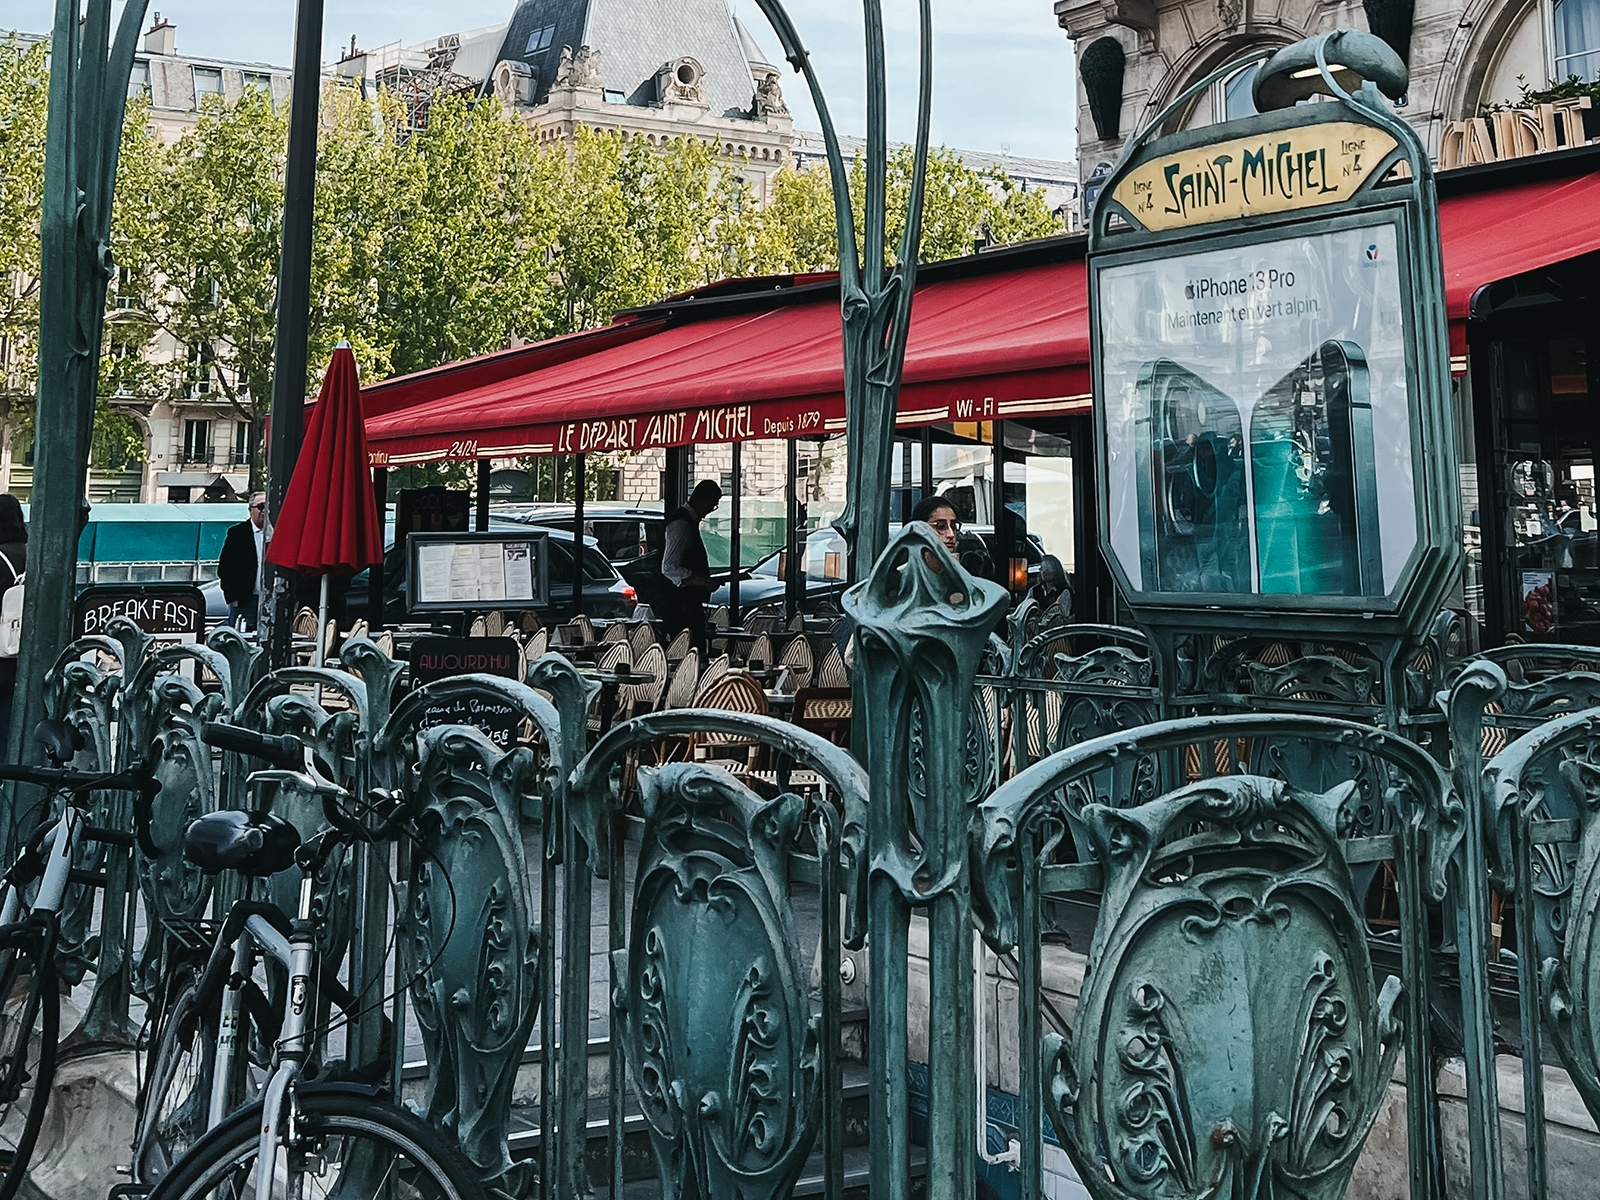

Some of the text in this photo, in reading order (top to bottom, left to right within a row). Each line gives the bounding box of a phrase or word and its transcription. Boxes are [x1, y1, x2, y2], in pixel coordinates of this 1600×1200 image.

[1196, 277, 1247, 299] iPhone
[1268, 269, 1296, 290] Pro
[1167, 306, 1237, 330] Maintenant
[1238, 307, 1255, 321] en
[1256, 299, 1283, 319] vert
[558, 424, 575, 452] LE
[640, 412, 687, 446] SAINT
[691, 404, 755, 441] MICHEL
[764, 416, 794, 438] Depuis
[797, 410, 820, 430] 1879
[448, 440, 478, 457] 24/24
[83, 598, 198, 634] BREAKFAST
